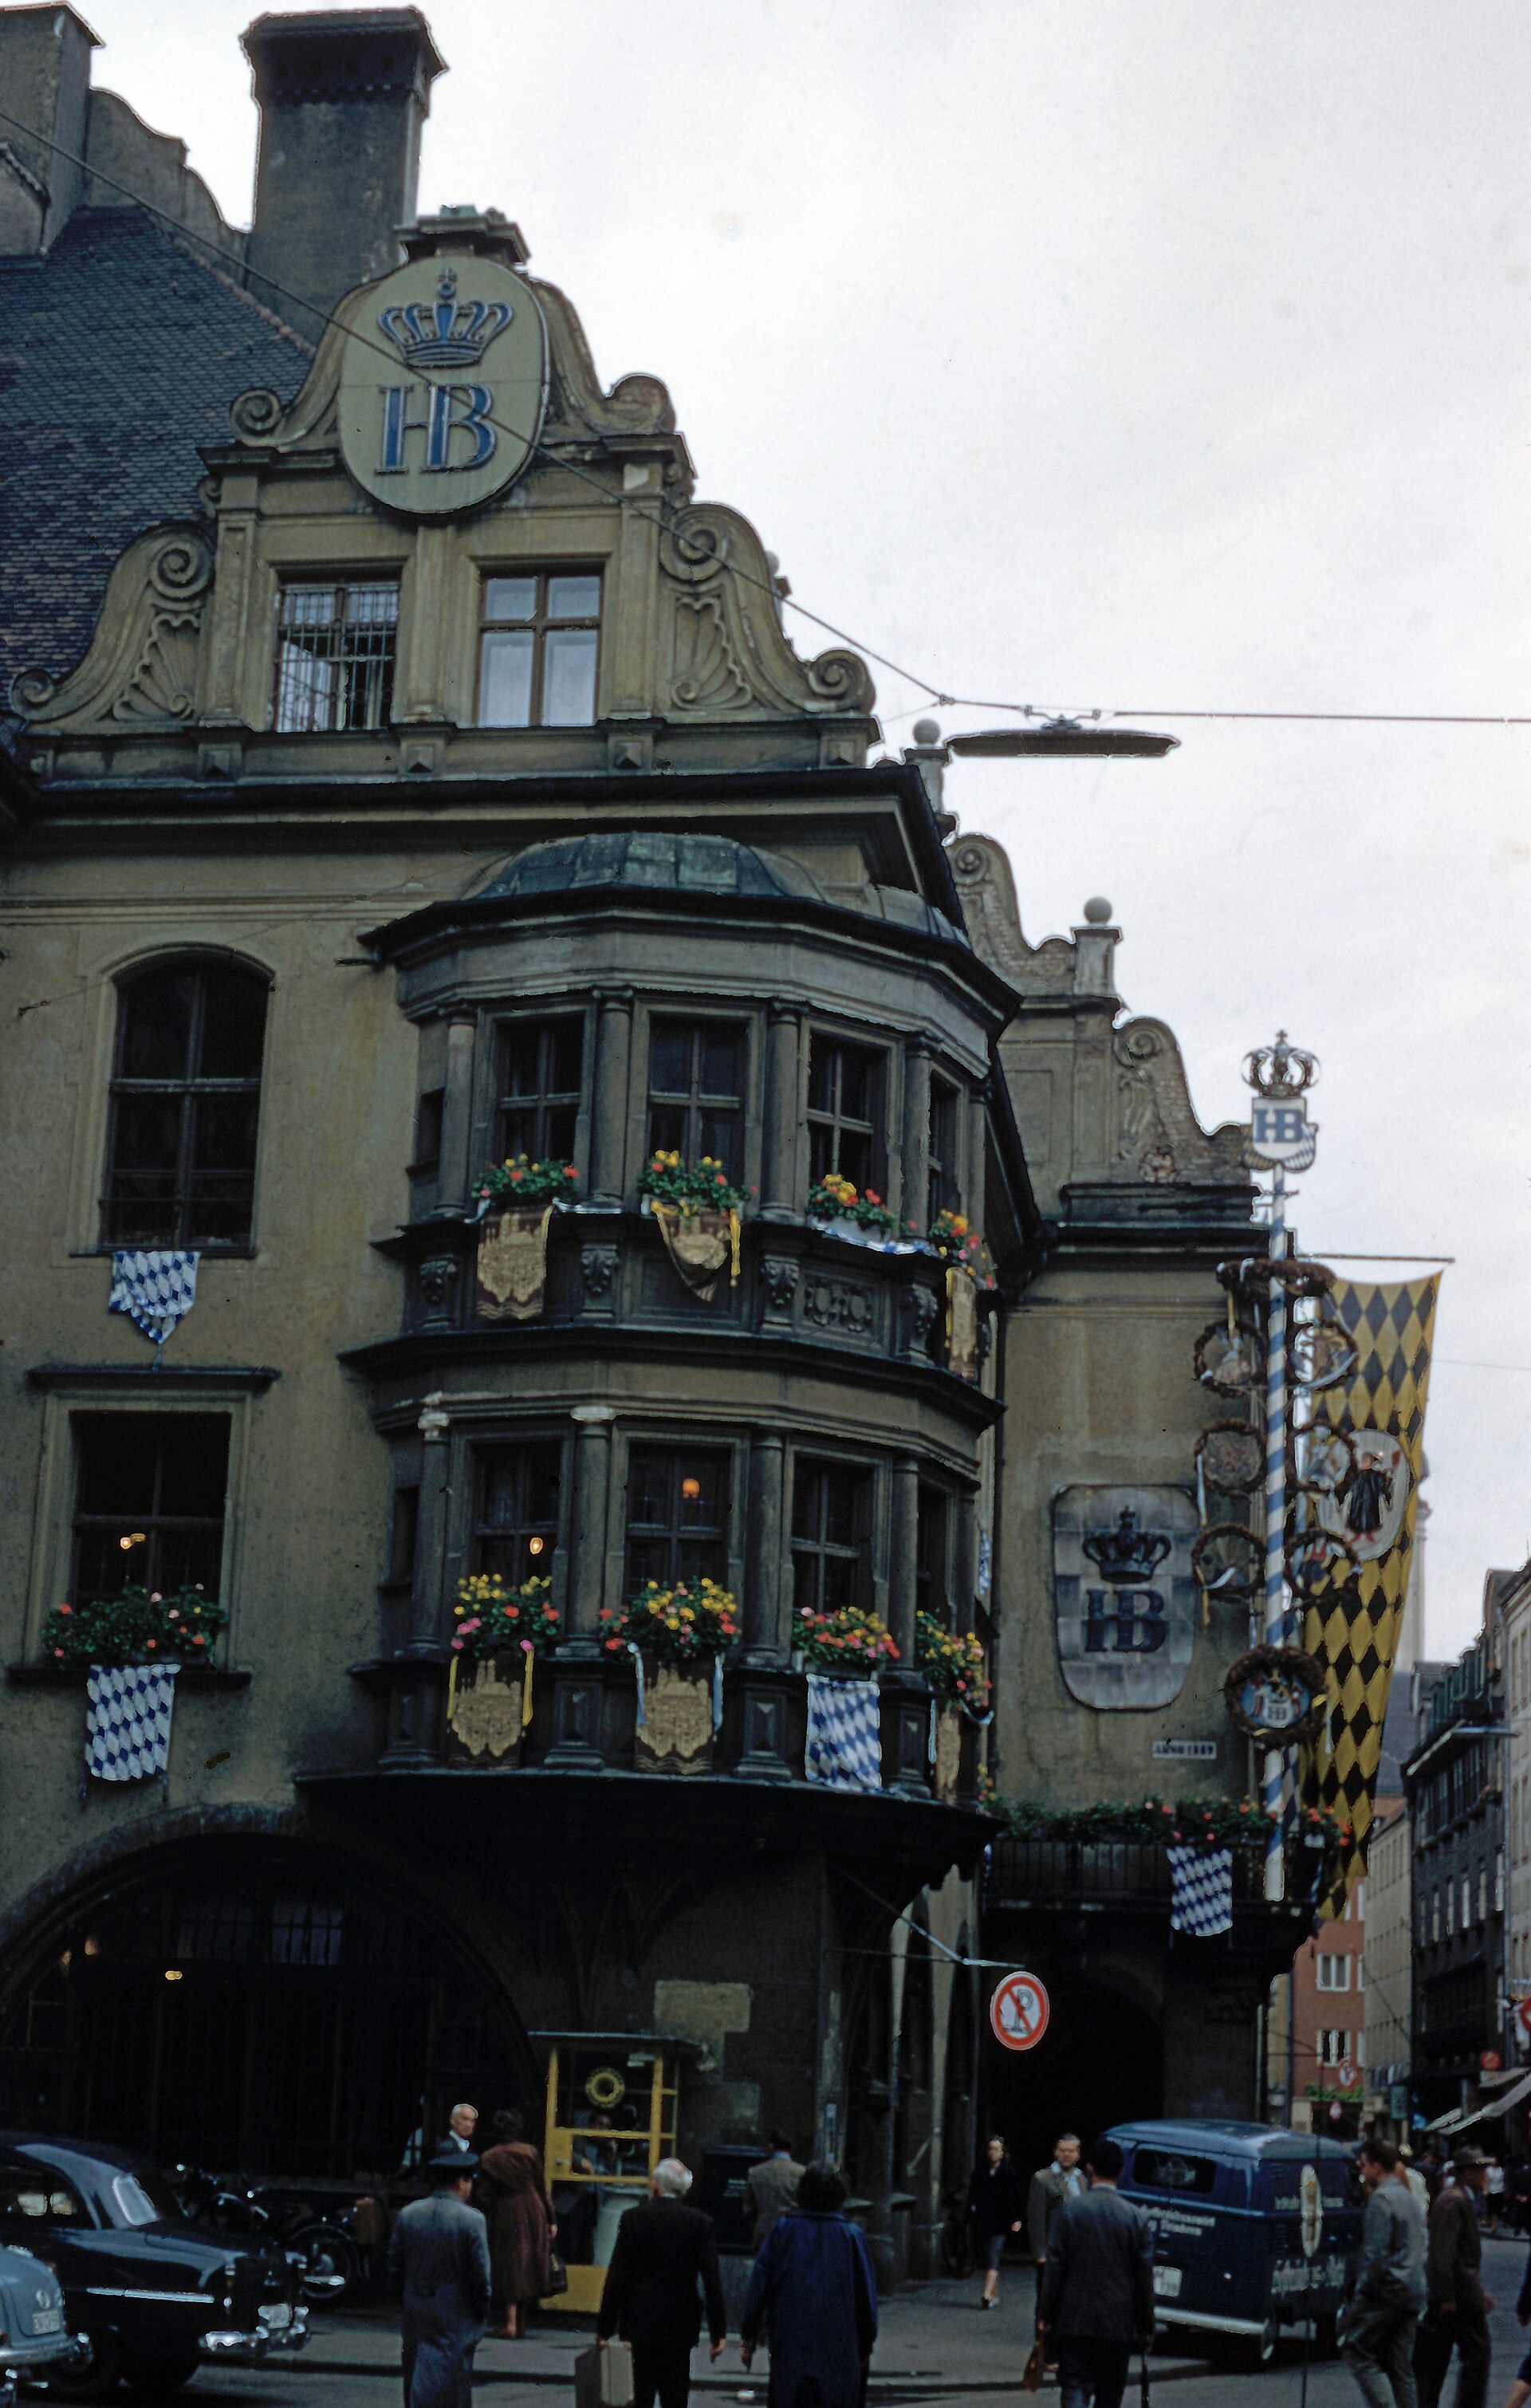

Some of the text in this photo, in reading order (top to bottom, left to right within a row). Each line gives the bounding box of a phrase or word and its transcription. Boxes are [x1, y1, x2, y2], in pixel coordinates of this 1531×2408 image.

[374, 383, 497, 475] HB
[1254, 1108, 1305, 1143] HB
[1083, 1590, 1169, 1653] HB
